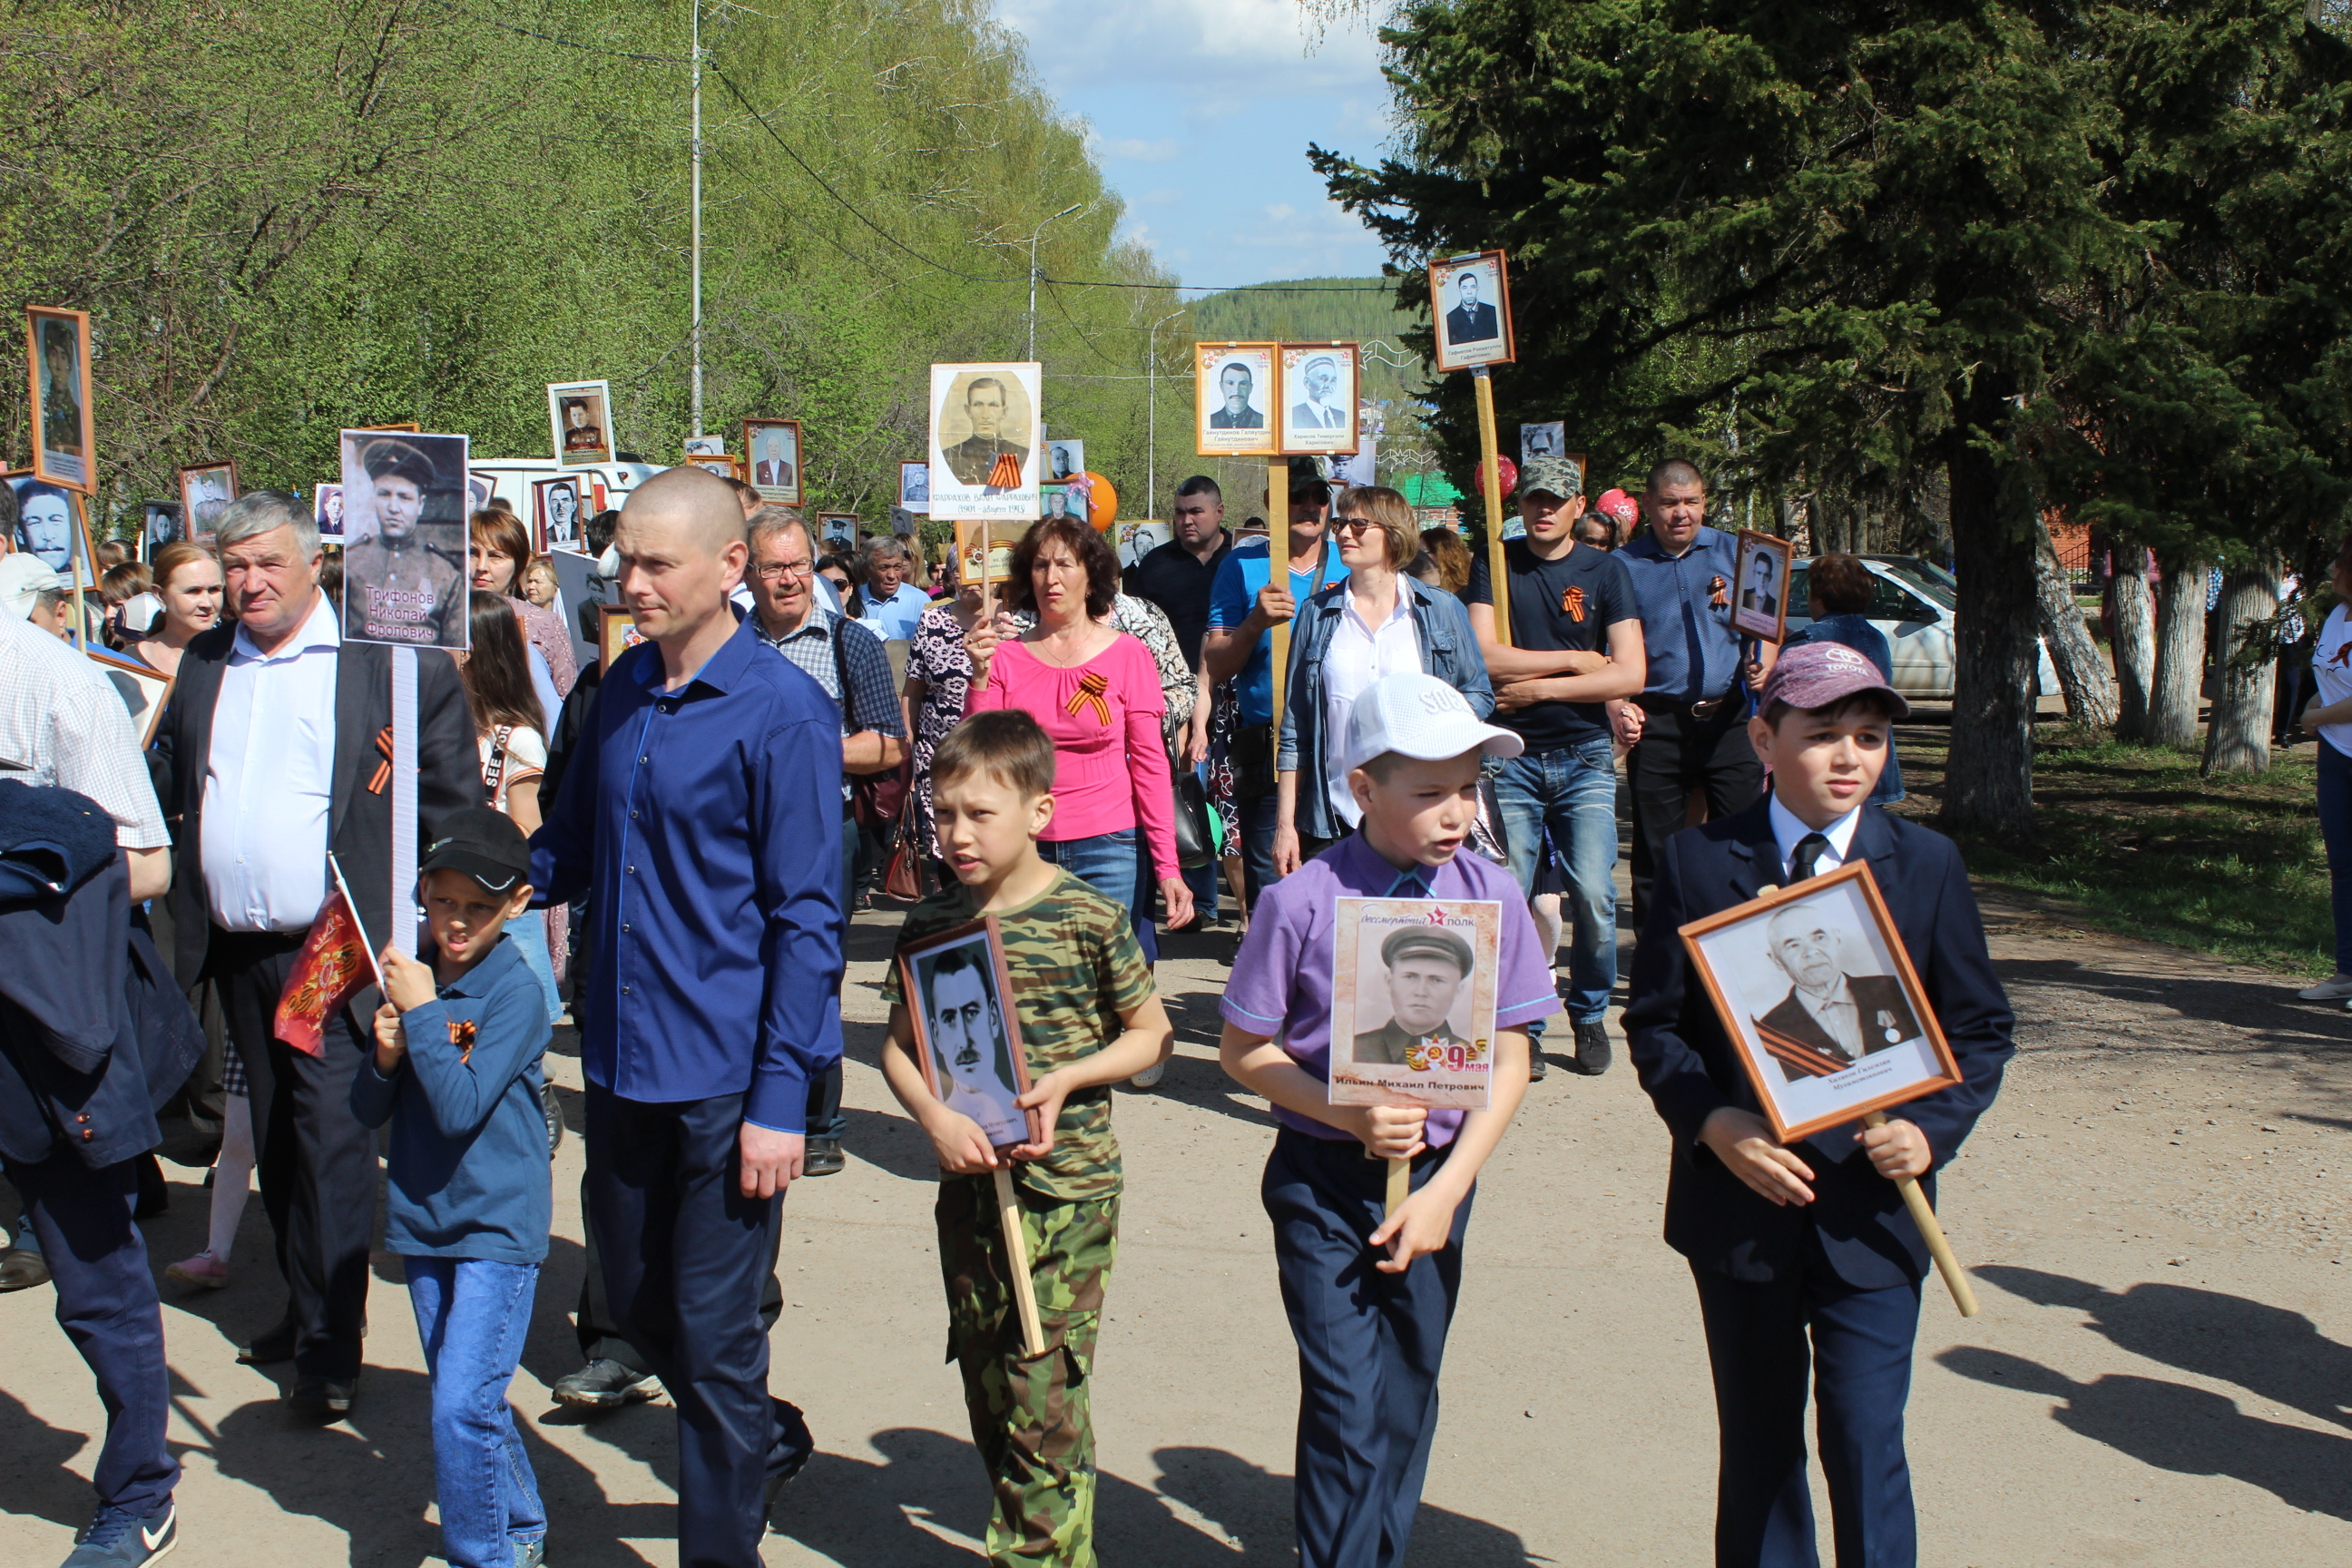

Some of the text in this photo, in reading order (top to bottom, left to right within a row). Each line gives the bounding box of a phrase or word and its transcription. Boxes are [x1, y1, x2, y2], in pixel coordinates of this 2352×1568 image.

[1202, 429, 1240, 437] Гайнутдинов
[933, 494, 971, 502] ФАРРАХОВ
[957, 505, 976, 514] (1901
[366, 586, 435, 604] Трифонов
[369, 604, 427, 622] Николай
[367, 622, 434, 639] Фролович
[1825, 663, 1868, 676] TOYOTA
[485, 726, 512, 788] SEE YOU
[1447, 1046, 1489, 1073] 9 мая
[1336, 1077, 1485, 1092] Ильин Михаил Петрович
